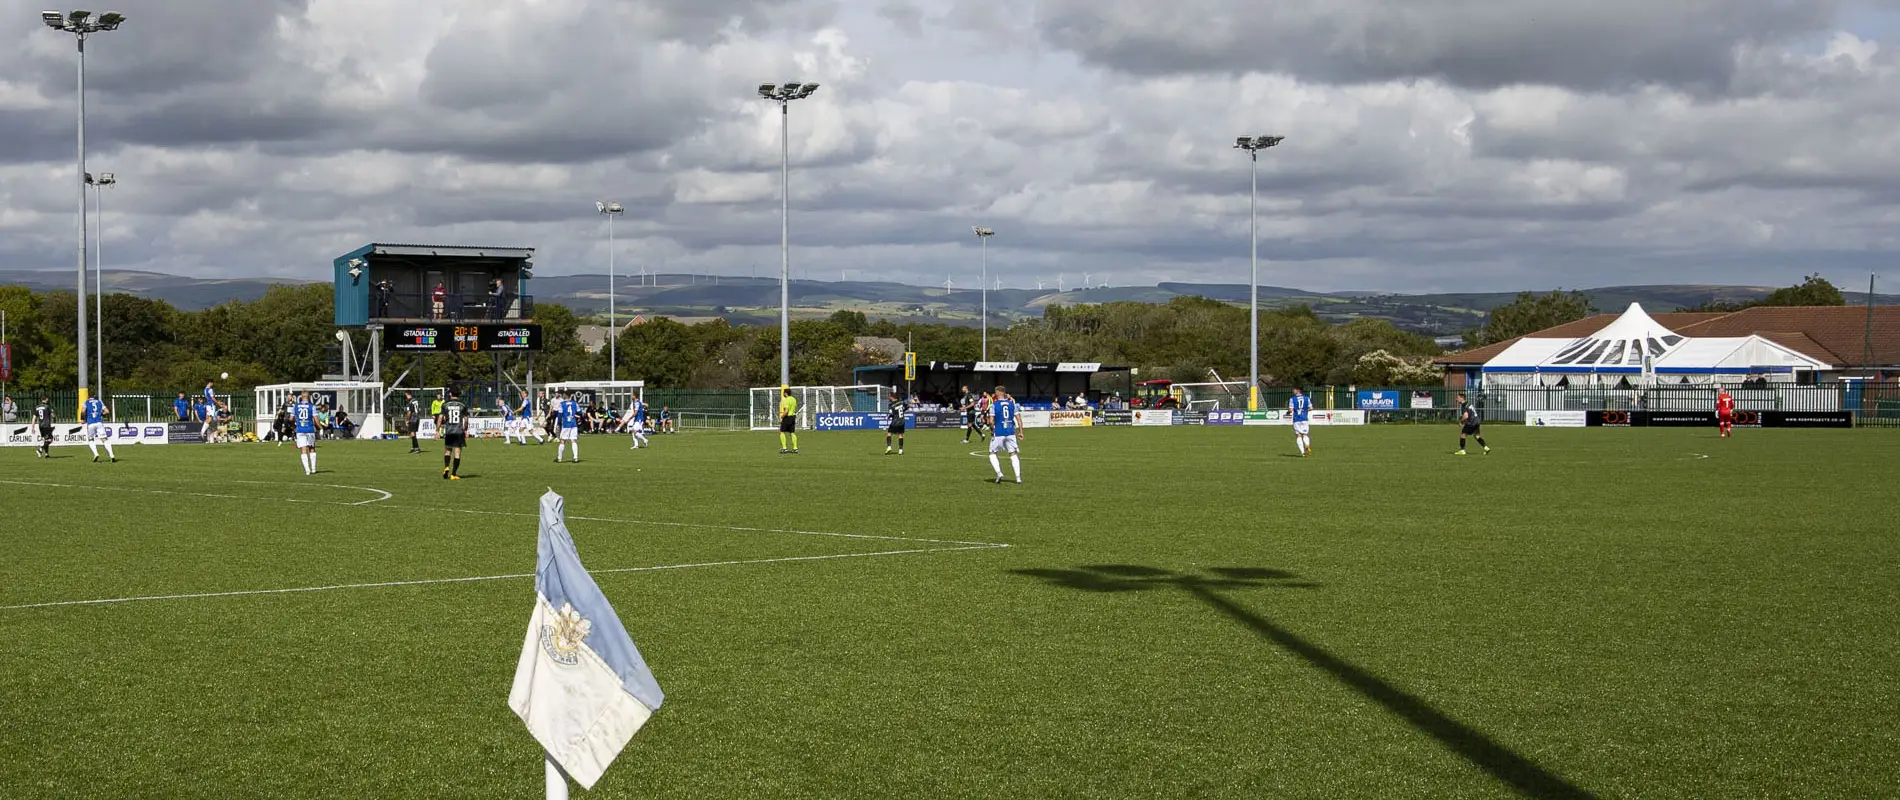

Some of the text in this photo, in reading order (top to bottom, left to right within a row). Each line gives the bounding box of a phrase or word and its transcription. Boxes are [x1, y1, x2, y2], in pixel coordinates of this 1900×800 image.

[454, 327, 478, 336] 20:13
[459, 341, 478, 350] 0 0
[92, 403, 97, 412] 5
[1002, 406, 1008, 418] 6
[38, 410, 44, 419] 9
[298, 408, 309, 419] 20
[448, 410, 460, 423] 18
[9, 435, 32, 443] CARLING
